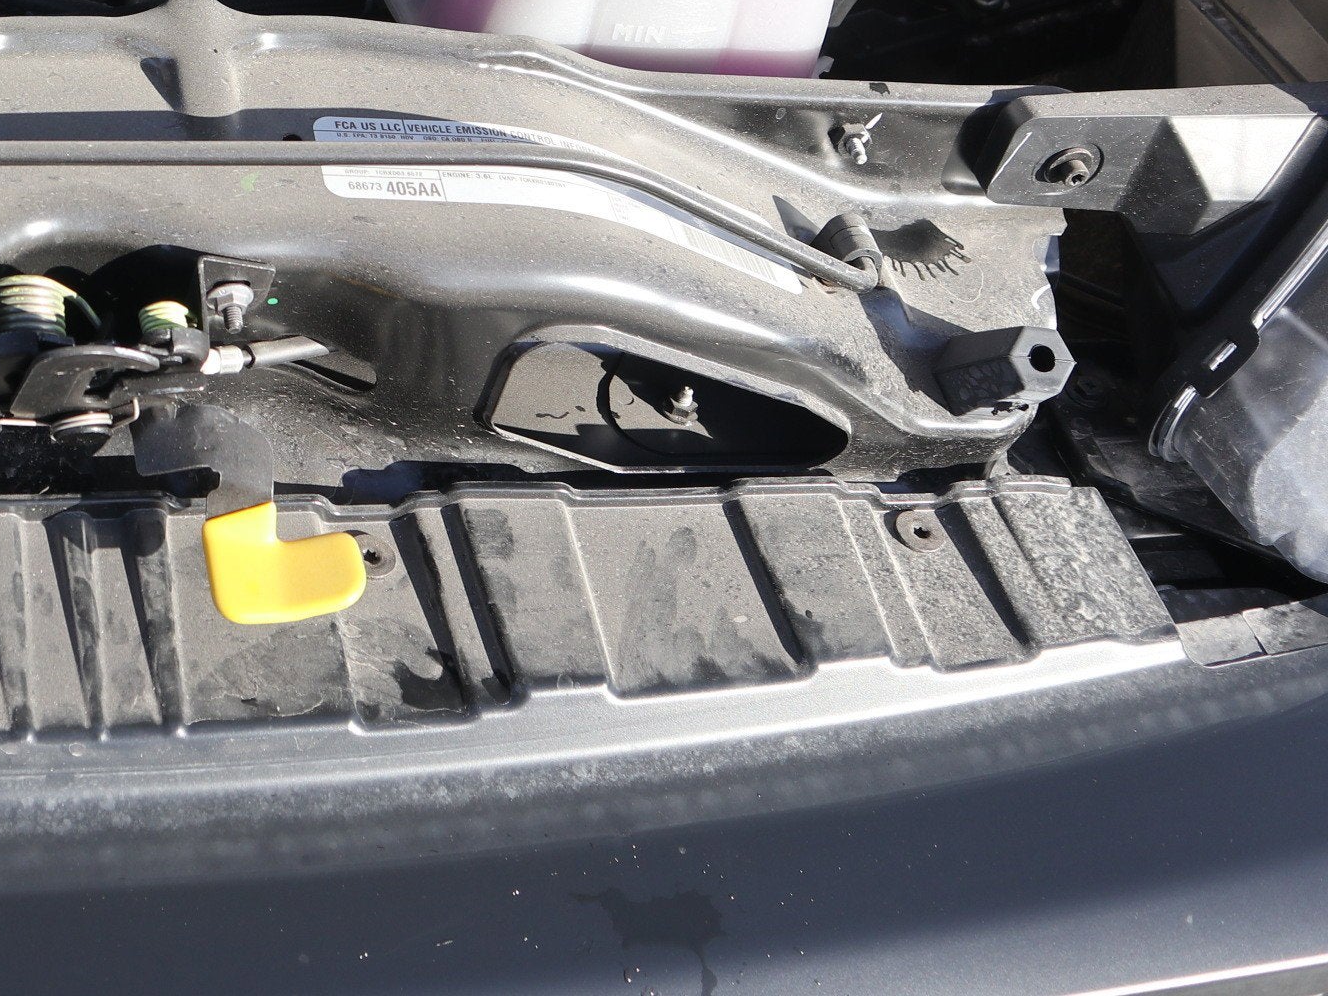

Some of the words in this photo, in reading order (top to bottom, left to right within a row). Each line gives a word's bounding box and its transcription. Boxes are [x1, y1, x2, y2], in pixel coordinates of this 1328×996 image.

[612, 23, 669, 43] MIN
[335, 120, 357, 130] FCA
[361, 122, 377, 131] US
[380, 122, 401, 132] LLC
[407, 124, 452, 134] VEHICLE
[456, 125, 508, 138] EMISSION
[510, 130, 556, 146] CONTROL
[348, 181, 383, 191] 68673
[386, 181, 442, 197] 405AA
